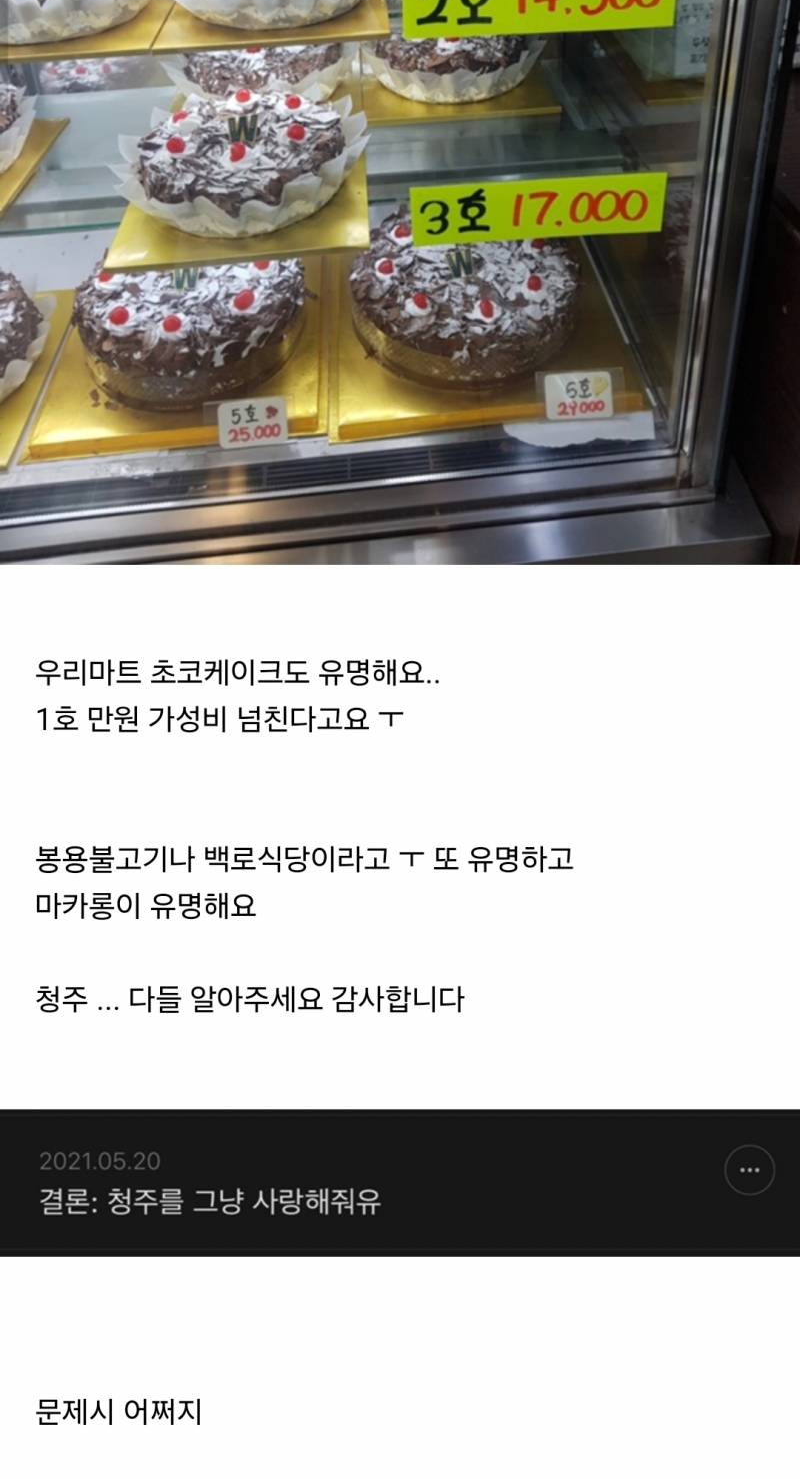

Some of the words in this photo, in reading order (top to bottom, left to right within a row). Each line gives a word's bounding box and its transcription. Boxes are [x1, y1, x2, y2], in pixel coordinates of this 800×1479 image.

[419, 187, 491, 235] 3호
[511, 189, 650, 228] 17.000
[231, 403, 259, 426] 5호
[38, 1150, 162, 1172] 2021.05.20
[38, 1186, 99, 1217] 결론:
[107, 1186, 186, 1217] 청주를
[192, 1186, 246, 1217] 그냥
[252, 1186, 383, 1217] 사랑해줘유
